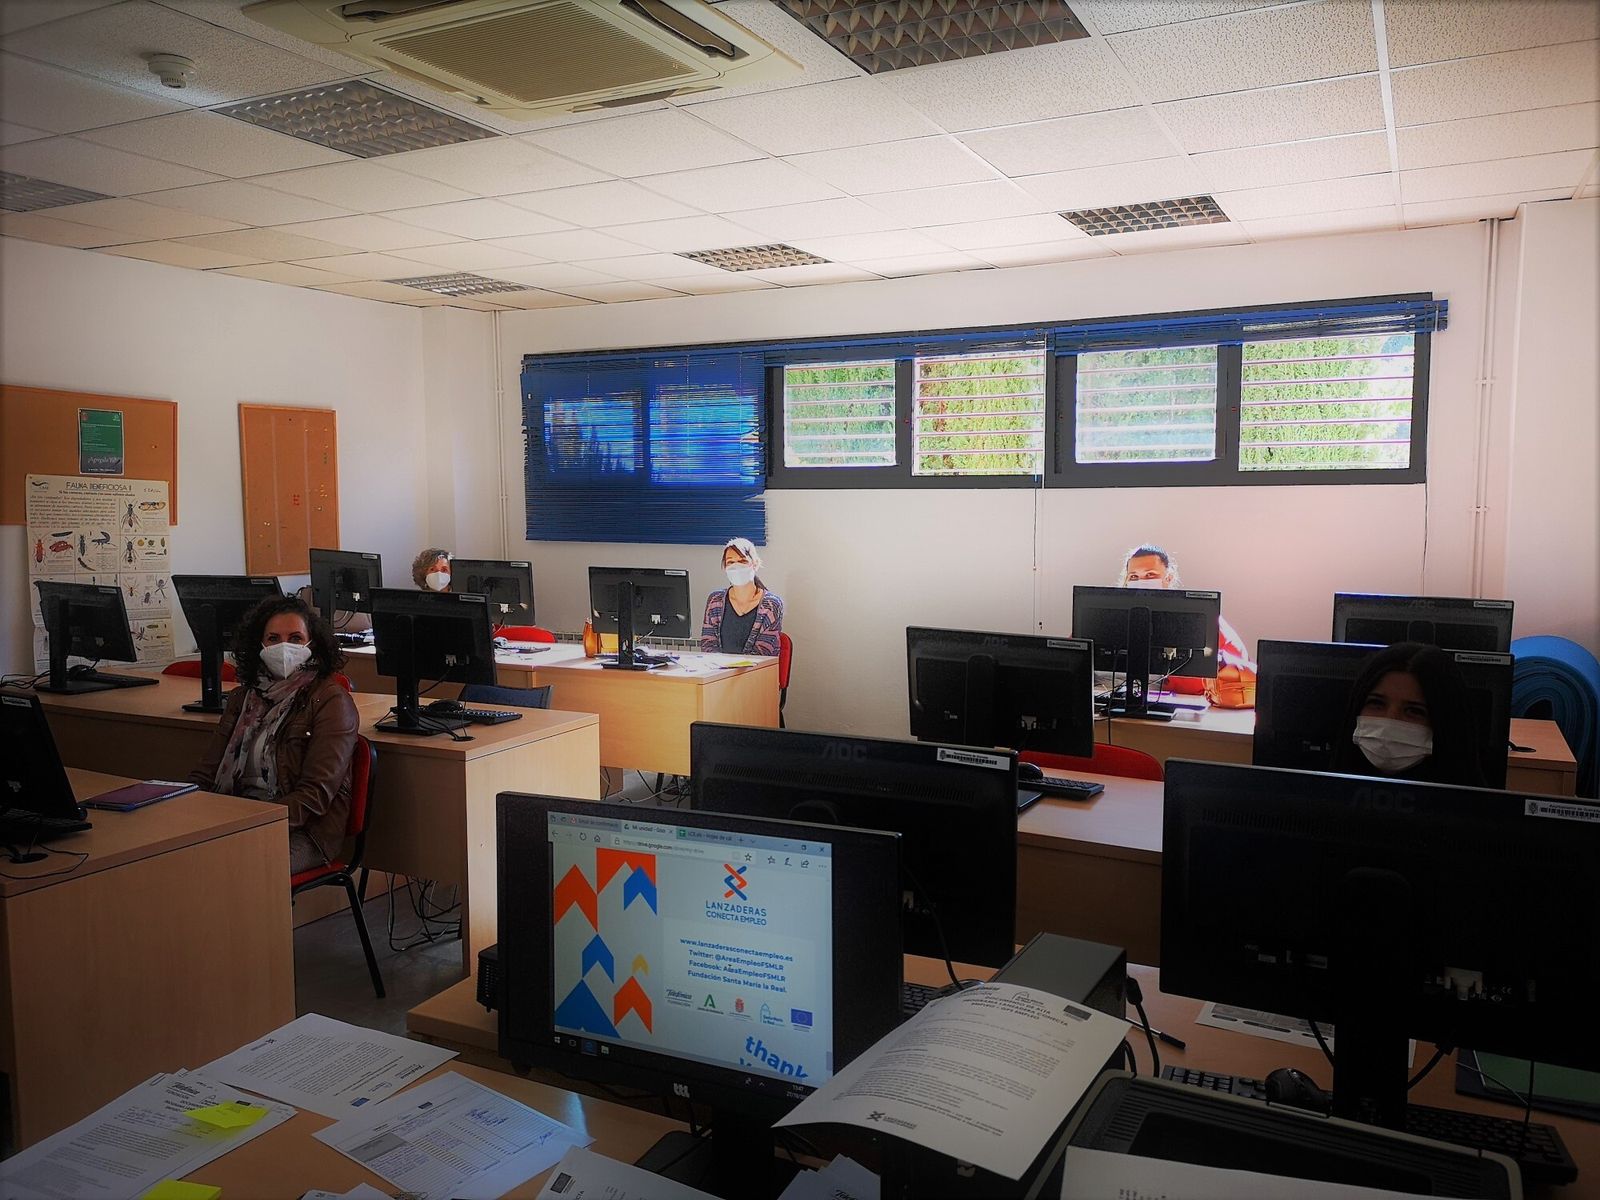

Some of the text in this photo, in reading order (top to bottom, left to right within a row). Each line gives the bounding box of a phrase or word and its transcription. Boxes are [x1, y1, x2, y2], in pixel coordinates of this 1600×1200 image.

[65, 481, 88, 490] FAUNA
[705, 900, 768, 917] LANZADERAS
[705, 910, 768, 927] CONECTA EMPLEO
[680, 938, 794, 962] www.lanzaderasconectaempleo.es
[688, 949, 785, 971] Twitter: @AreaEmpleoFSMLR
[688, 959, 721, 972] Facebook:
[722, 976, 742, 985] Santa
